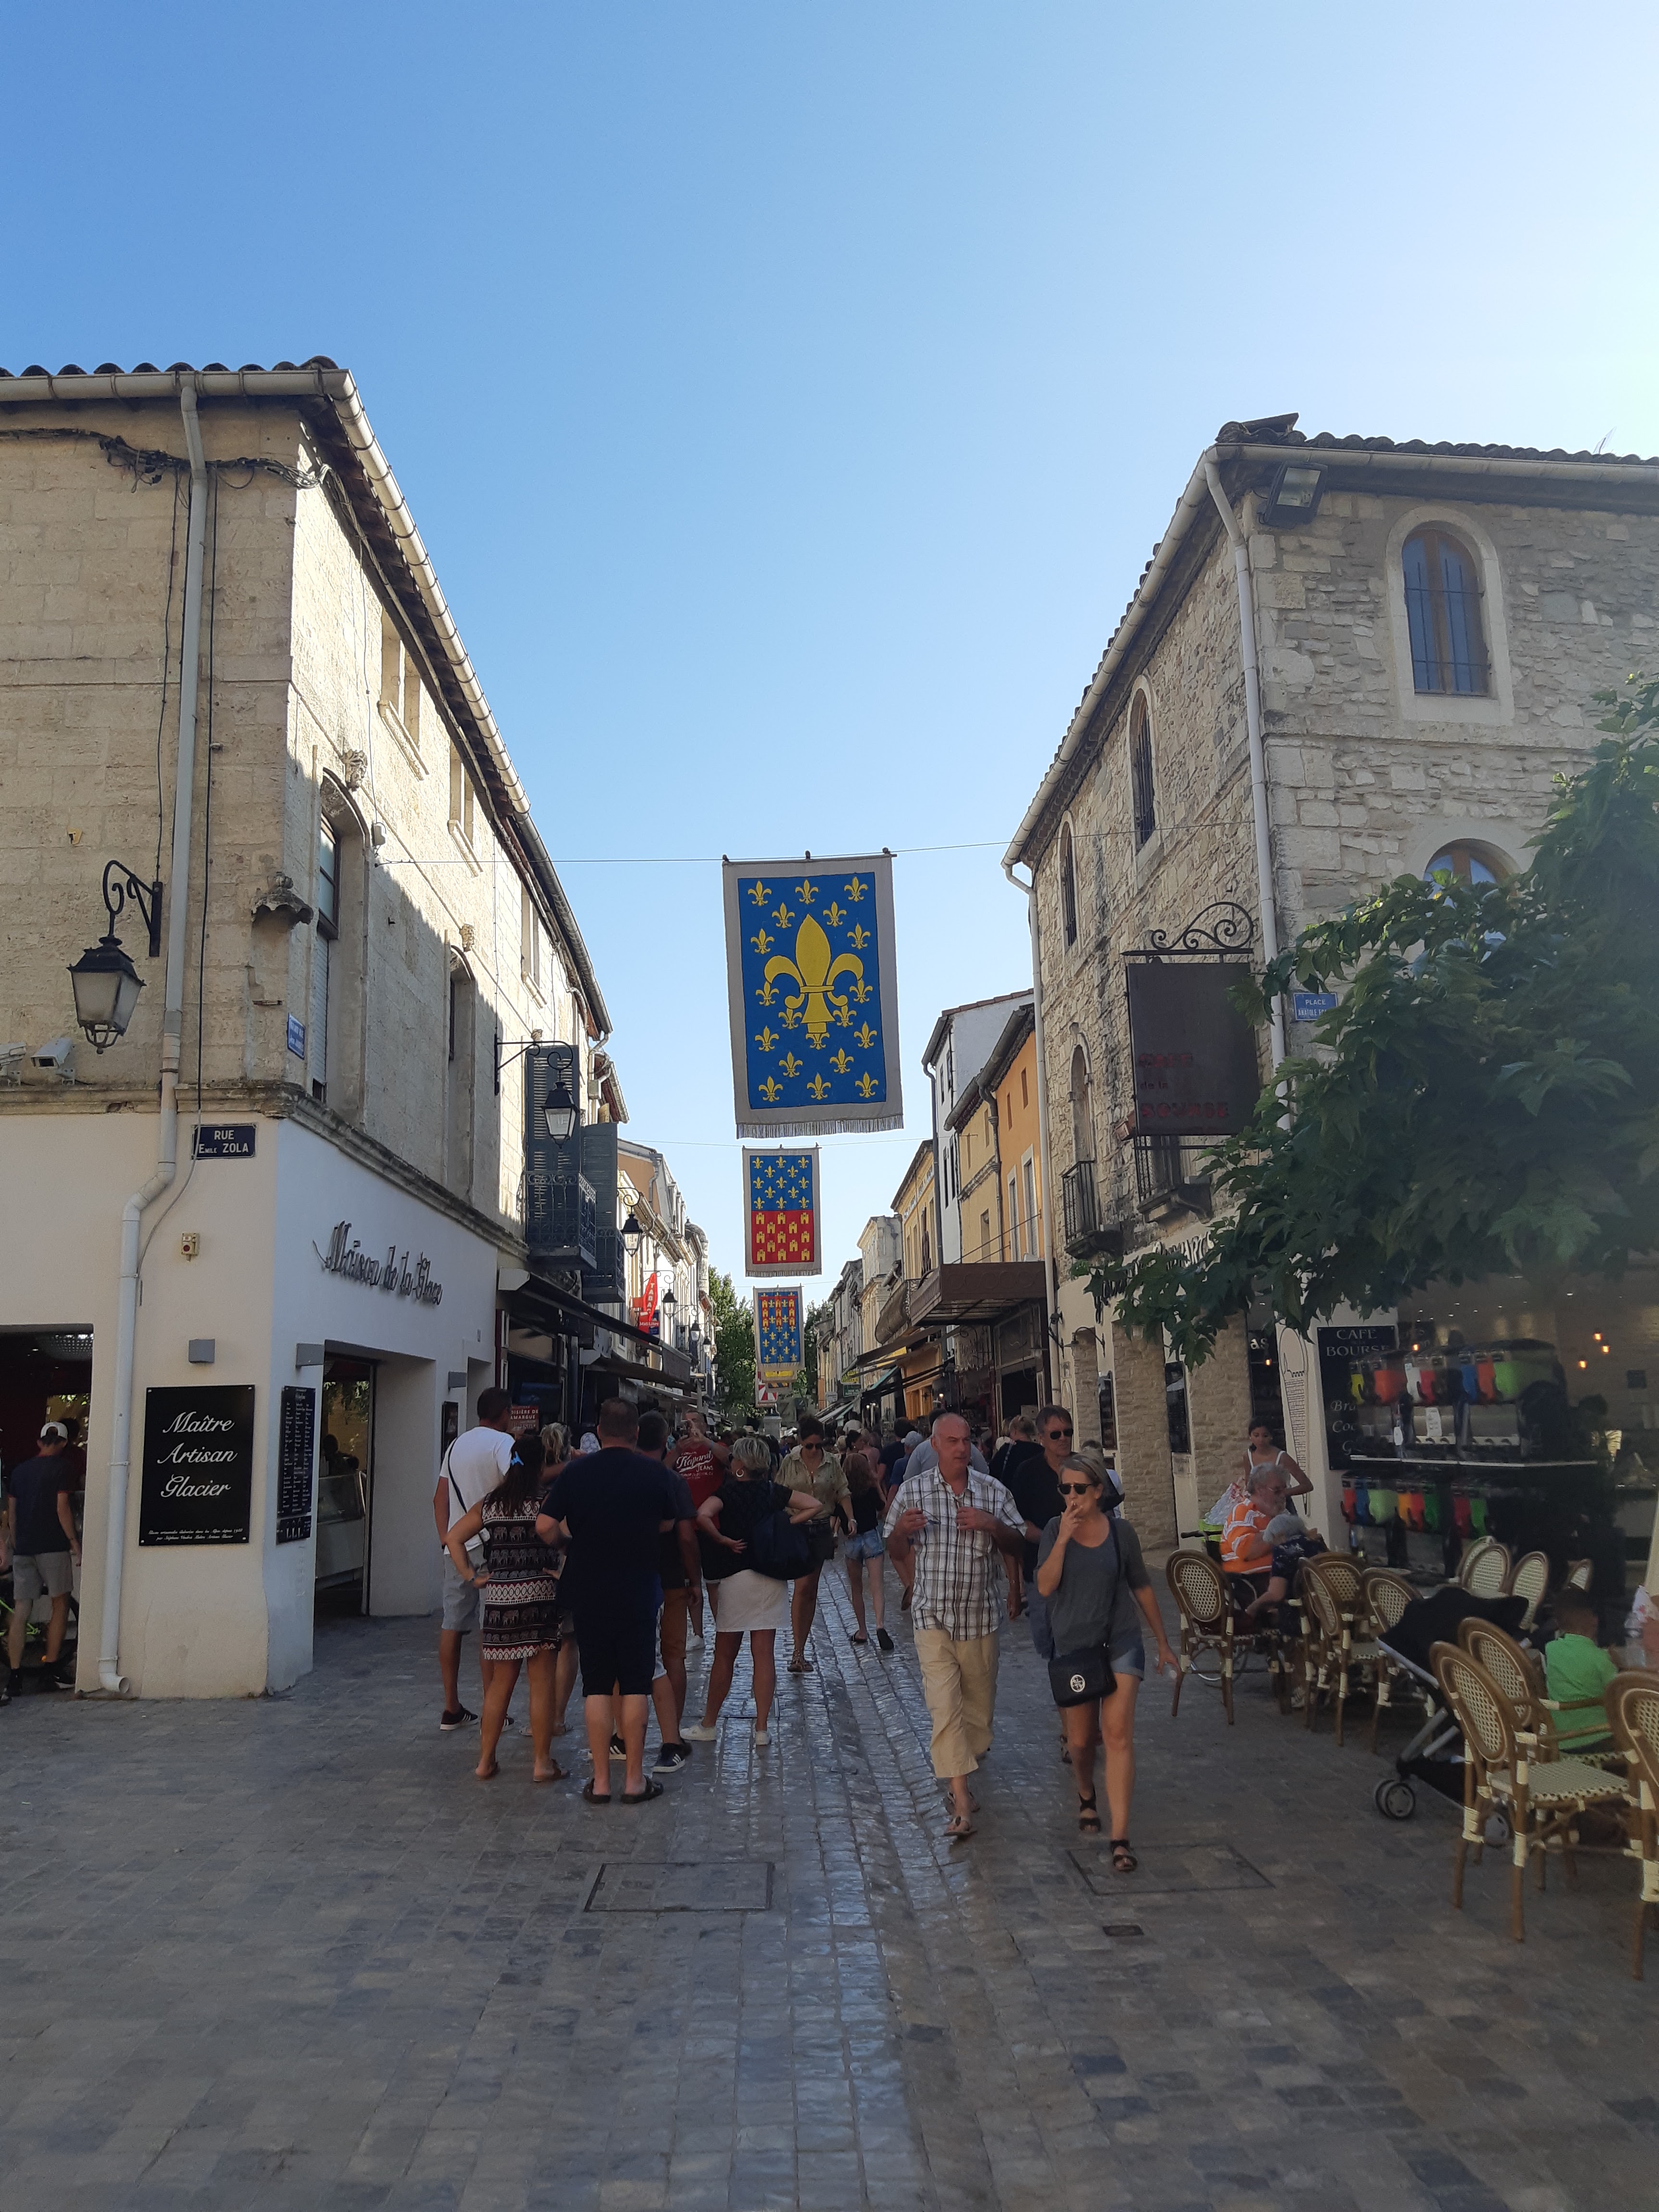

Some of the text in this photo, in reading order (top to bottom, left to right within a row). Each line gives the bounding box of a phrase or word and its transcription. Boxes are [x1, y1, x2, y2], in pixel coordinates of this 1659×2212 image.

[214, 1130, 234, 1140] RUE
[222, 1143, 249, 1153] ZOLA
[384, 1245, 398, 1291] de
[400, 1251, 413, 1296] la
[162, 1411, 235, 1433] Maître
[157, 1443, 238, 1464] Artisan
[696, 1465, 714, 1473] JEANS
[160, 1474, 232, 1498] Glacier
